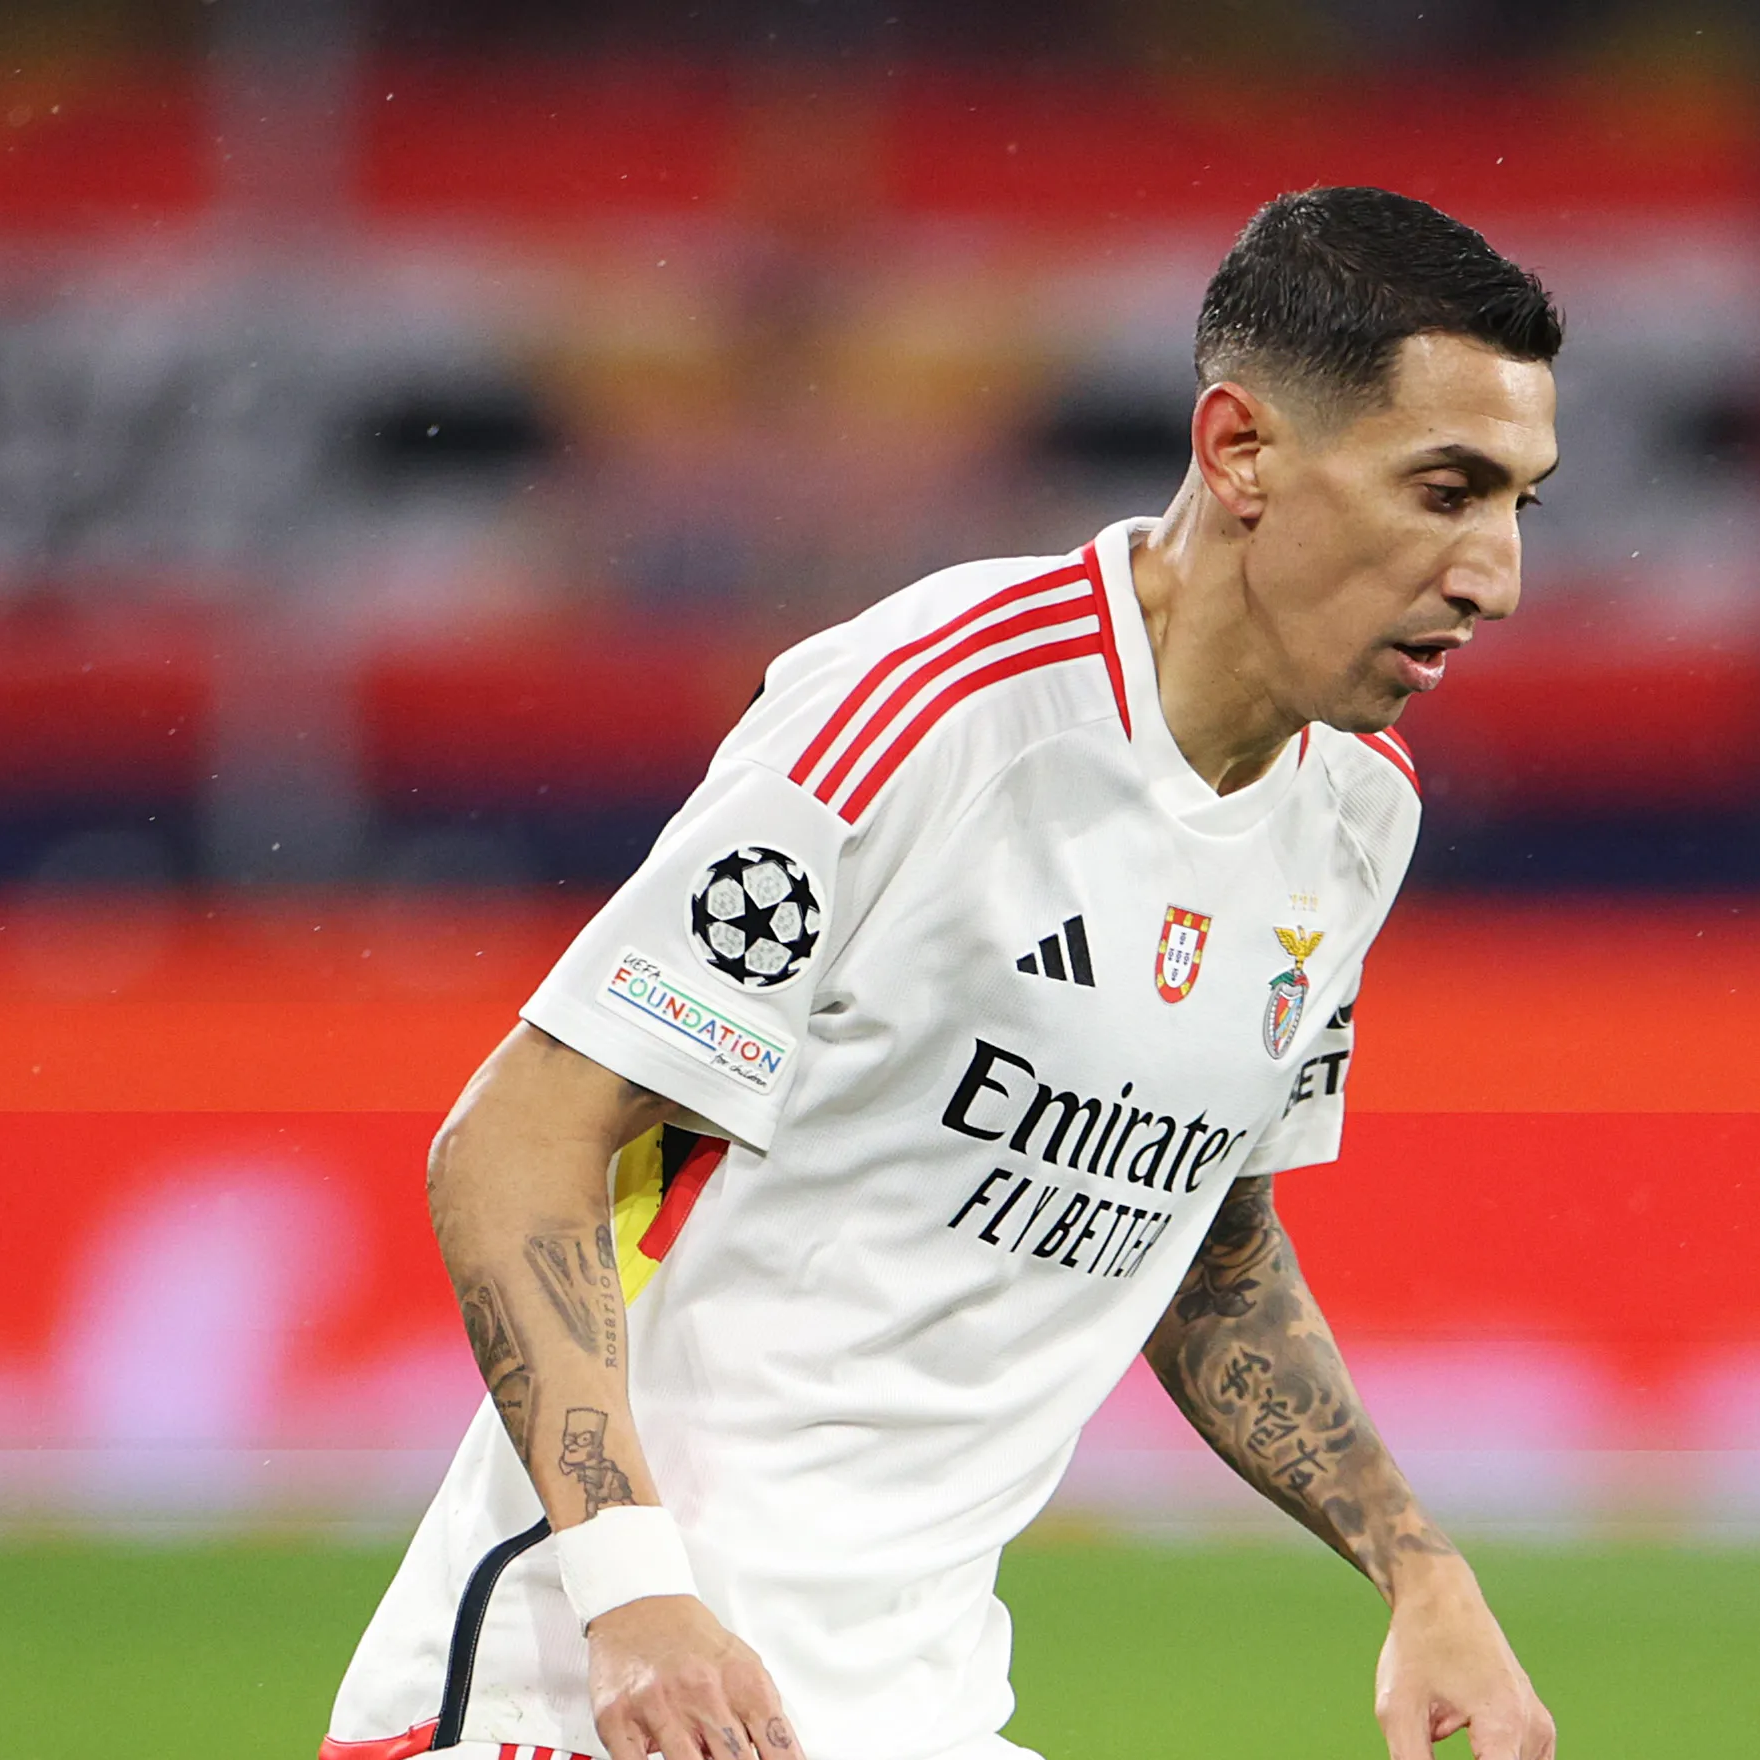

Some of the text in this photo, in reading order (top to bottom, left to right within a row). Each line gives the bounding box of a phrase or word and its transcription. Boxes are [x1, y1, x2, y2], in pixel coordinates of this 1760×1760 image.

[623, 953, 660, 981] UEFA
[612, 967, 781, 1074] FOUNDATION
[1281, 1050, 1349, 1120] ET
[948, 1168, 1172, 1278] FLY BETTER
